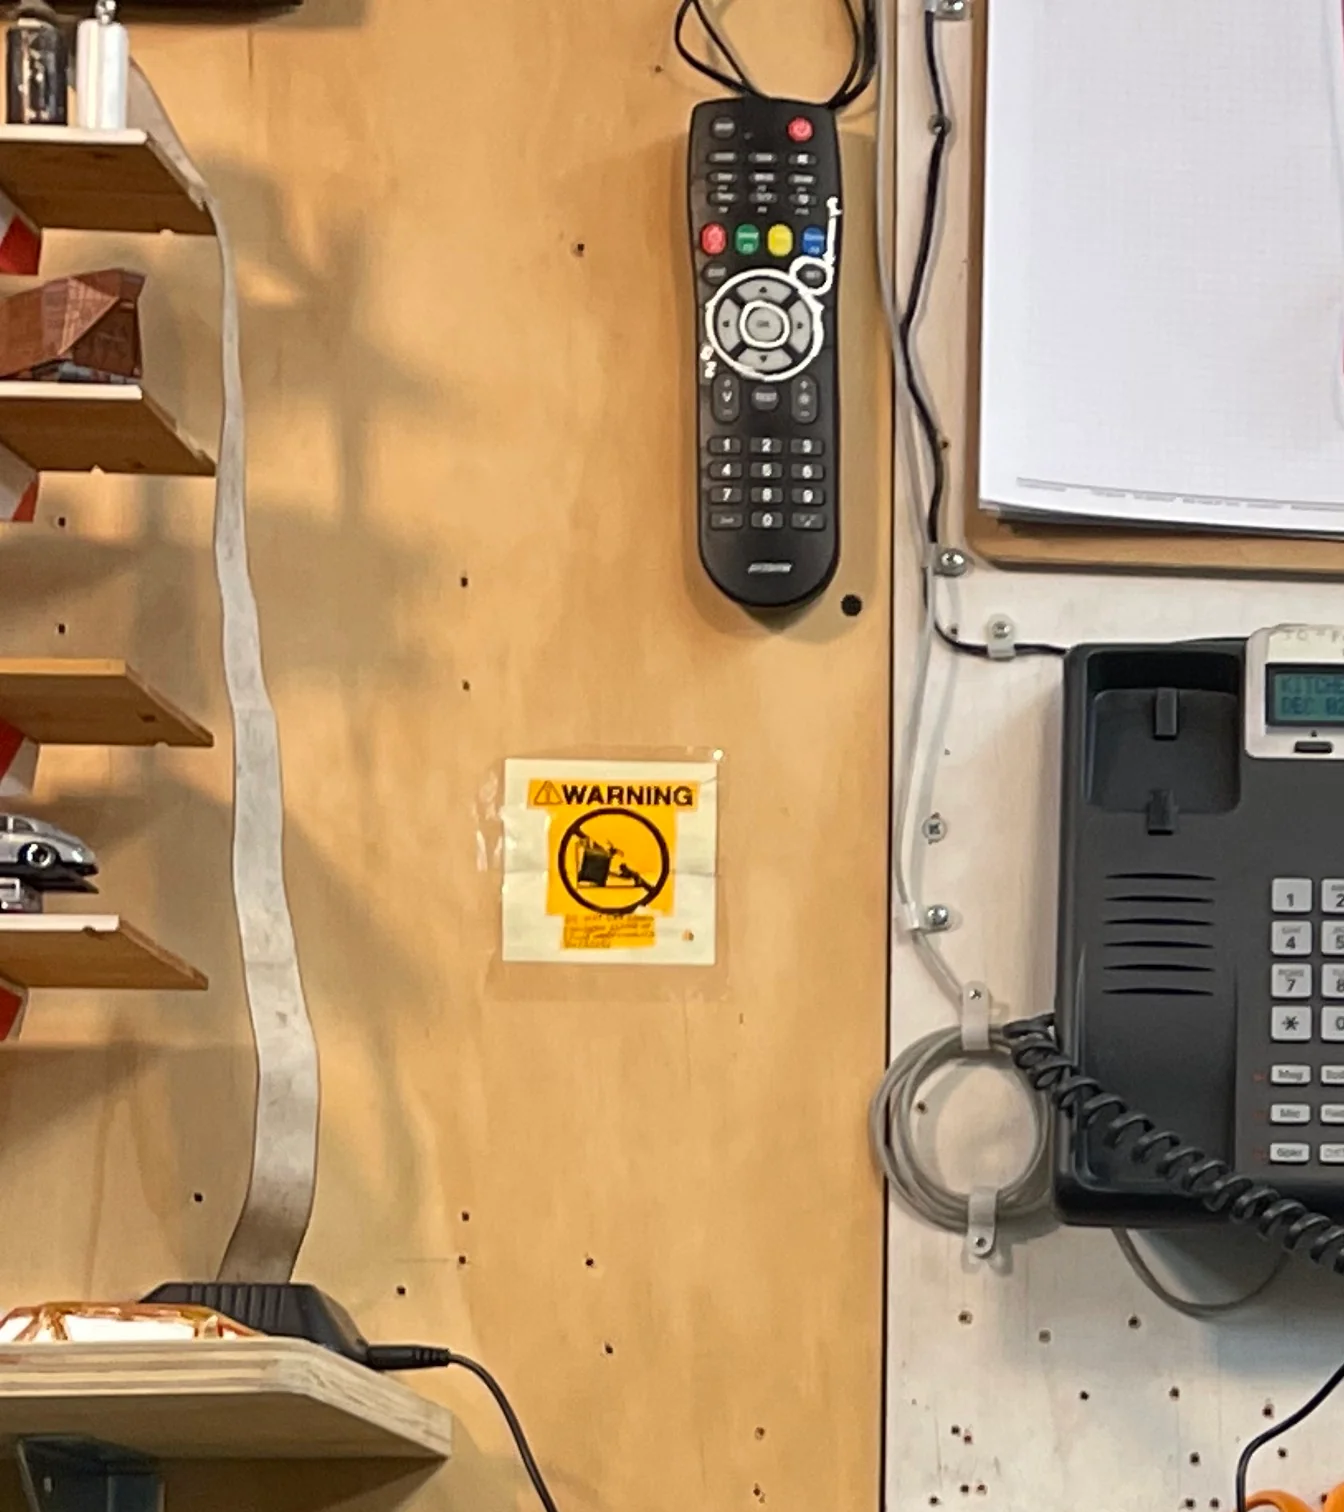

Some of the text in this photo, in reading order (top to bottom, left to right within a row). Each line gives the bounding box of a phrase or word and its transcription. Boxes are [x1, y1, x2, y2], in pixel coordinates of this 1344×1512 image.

[761, 438, 772, 452] 2
[1281, 698, 1309, 716] DEC
[561, 784, 693, 806] WARNING
[1286, 893, 1294, 907] 1
[1285, 936, 1296, 949] 4
[1287, 979, 1296, 992] 7
